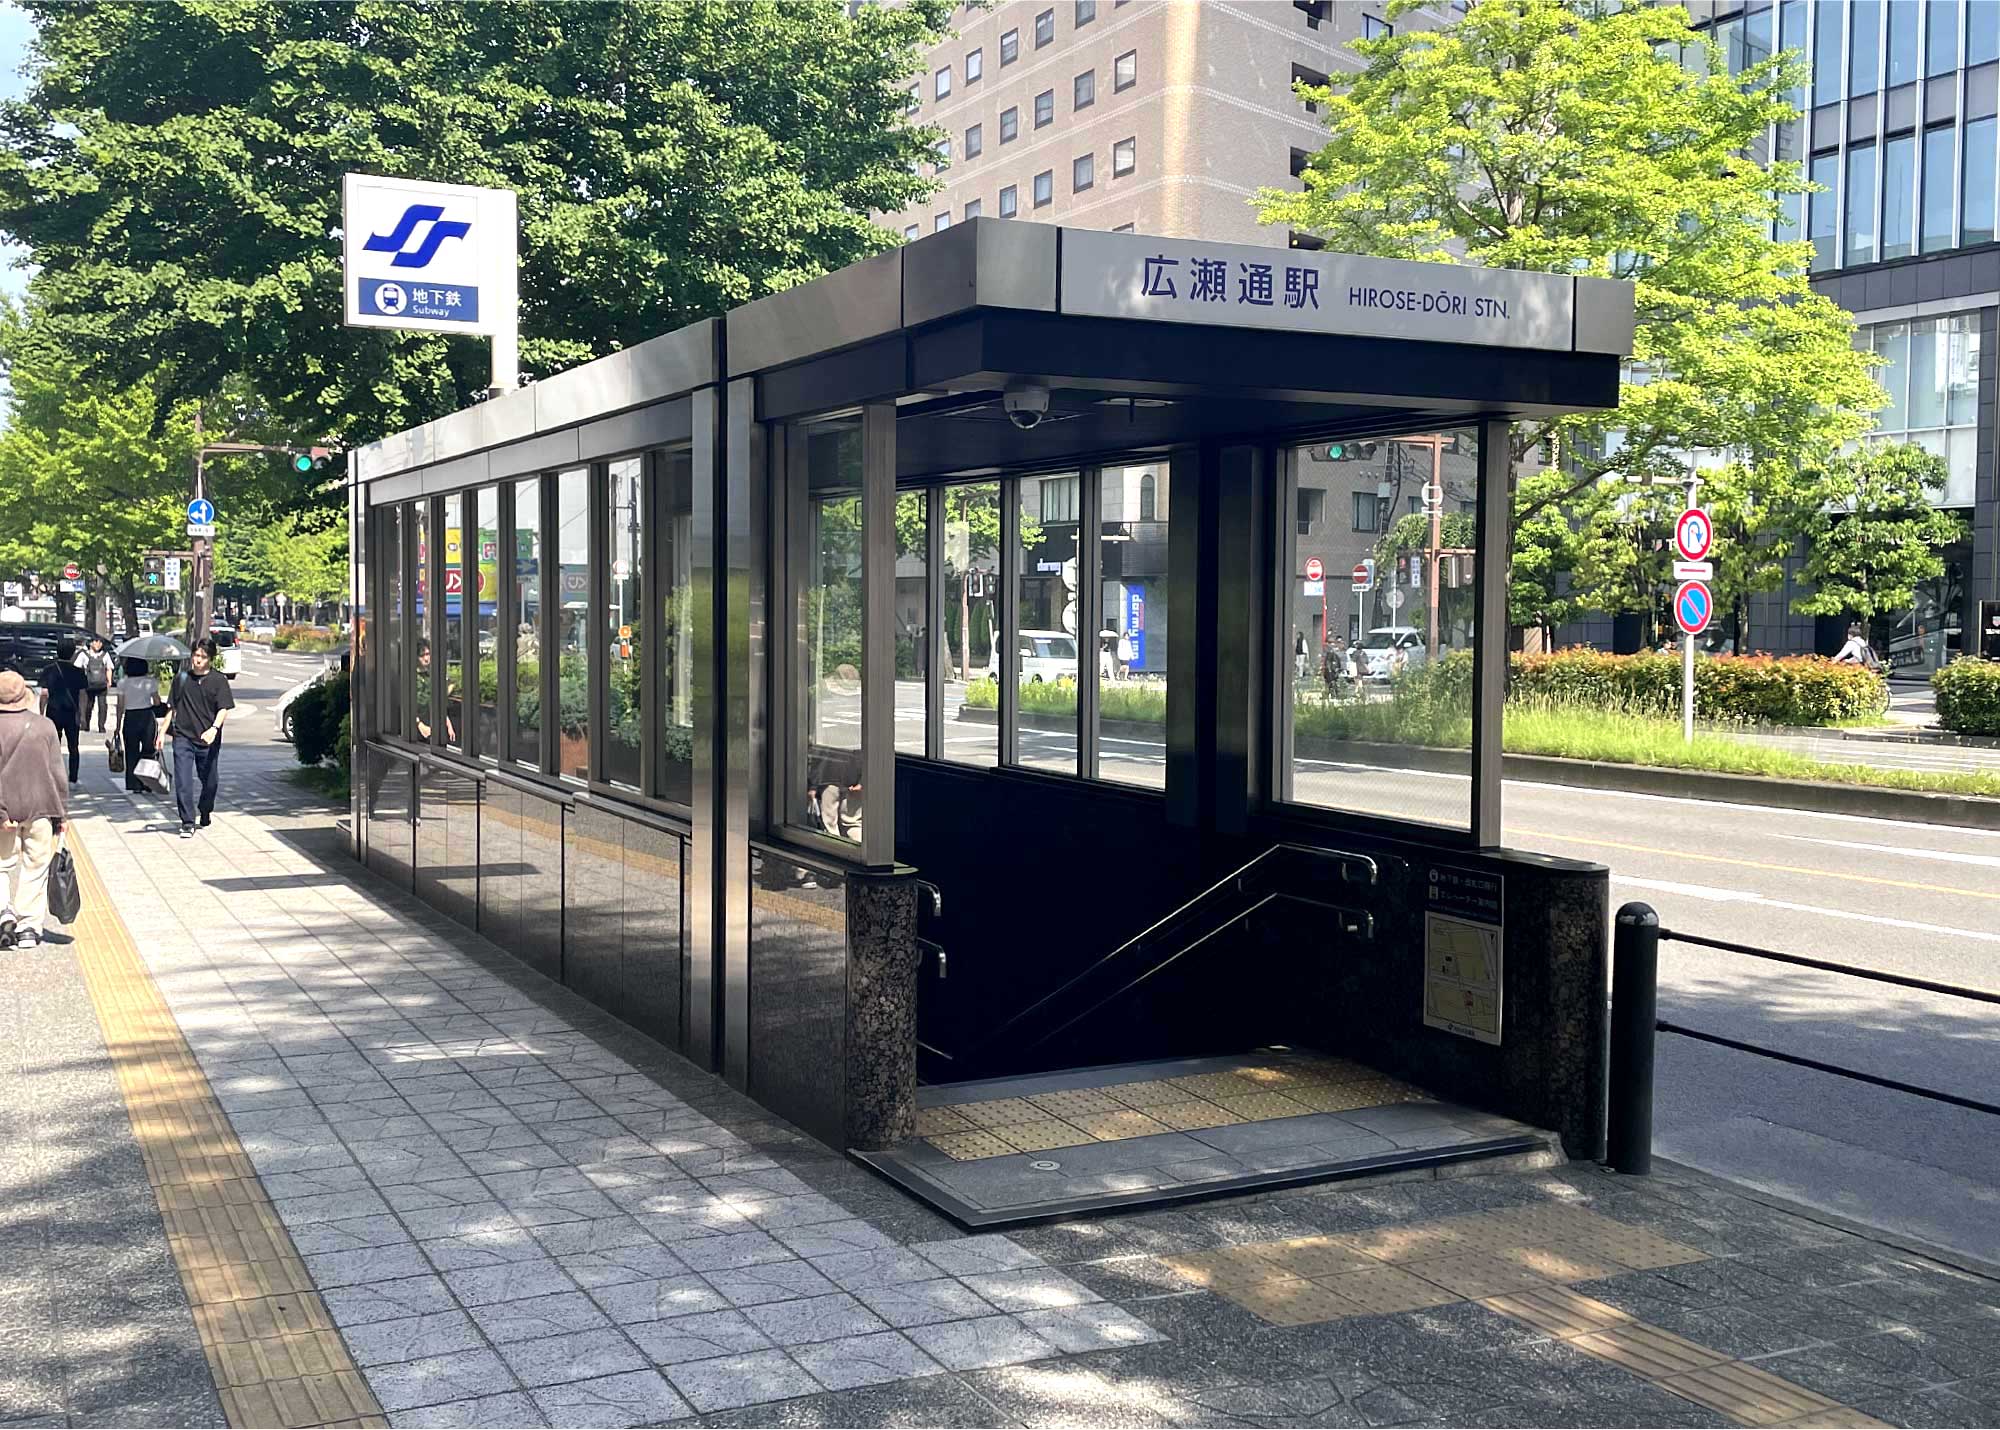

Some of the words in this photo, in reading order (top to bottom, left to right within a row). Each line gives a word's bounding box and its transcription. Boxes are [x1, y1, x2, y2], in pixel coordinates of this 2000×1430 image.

[412, 287, 462, 307] 地下鉄
[1141, 254, 1319, 310] 広瀬通駅
[412, 305, 450, 317] Subway
[1349, 286, 1466, 316] HIROSE-DŌRI
[1474, 297, 1510, 320] STN.
[1128, 594, 1143, 637] dormy
